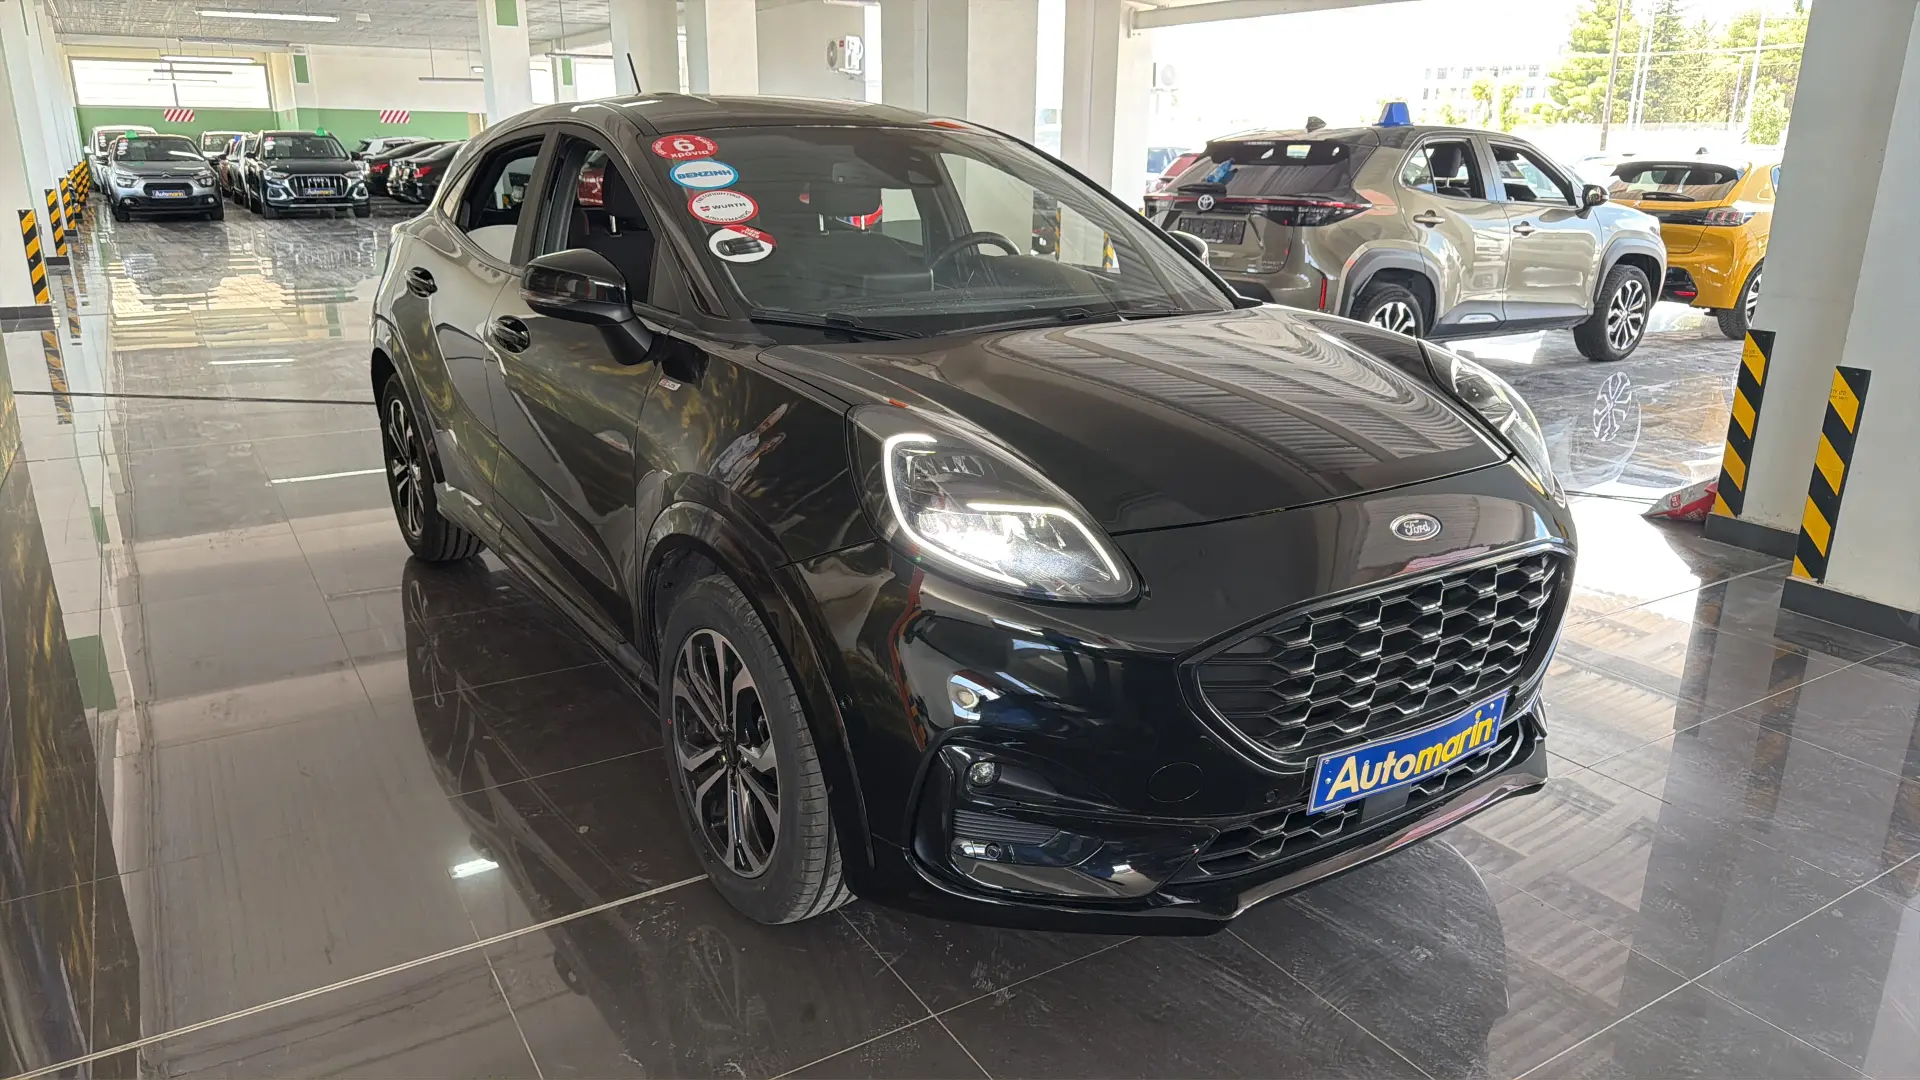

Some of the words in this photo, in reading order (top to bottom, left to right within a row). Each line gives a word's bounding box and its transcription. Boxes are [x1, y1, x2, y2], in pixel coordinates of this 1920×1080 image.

[673, 139, 695, 152] 6
[670, 150, 710, 158] χρόνια
[1403, 519, 1431, 536] Ford
[1325, 709, 1494, 801] Automarin
